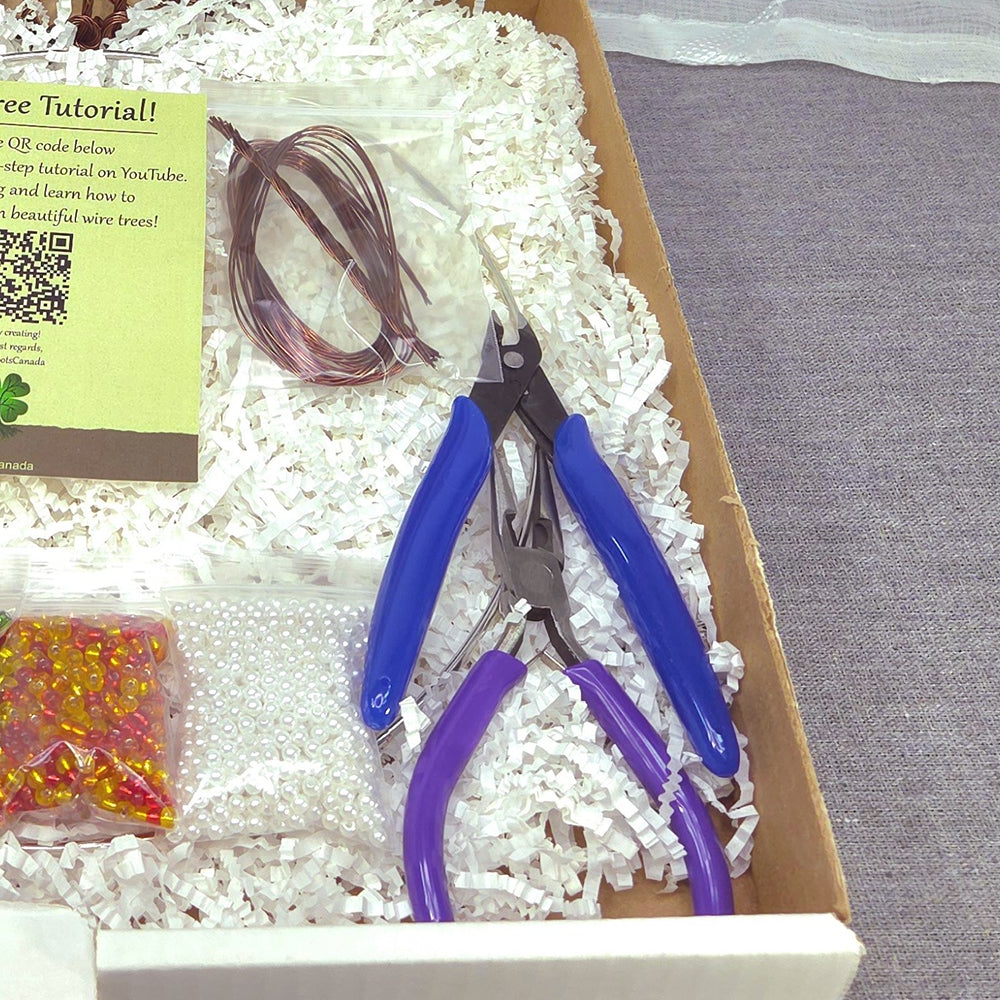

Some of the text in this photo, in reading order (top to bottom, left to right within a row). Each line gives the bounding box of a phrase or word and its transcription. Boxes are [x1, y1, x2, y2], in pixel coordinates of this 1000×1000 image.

[39, 94, 157, 123] Tutorial!
[7, 136, 33, 155] QR
[35, 137, 70, 153] code
[73, 138, 116, 156] below
[38, 162, 94, 178] tutorial
[97, 168, 117, 179] on
[120, 166, 188, 182] YouTube.
[9, 182, 40, 198] and
[43, 183, 81, 200] learn
[85, 185, 117, 202] how
[121, 190, 136, 203] to
[10, 204, 79, 227] beautiful
[81, 212, 114, 226] wire
[118, 214, 159, 228] trees!
[4, 329, 41, 340] creating!
[9, 342, 43, 353] regards,
